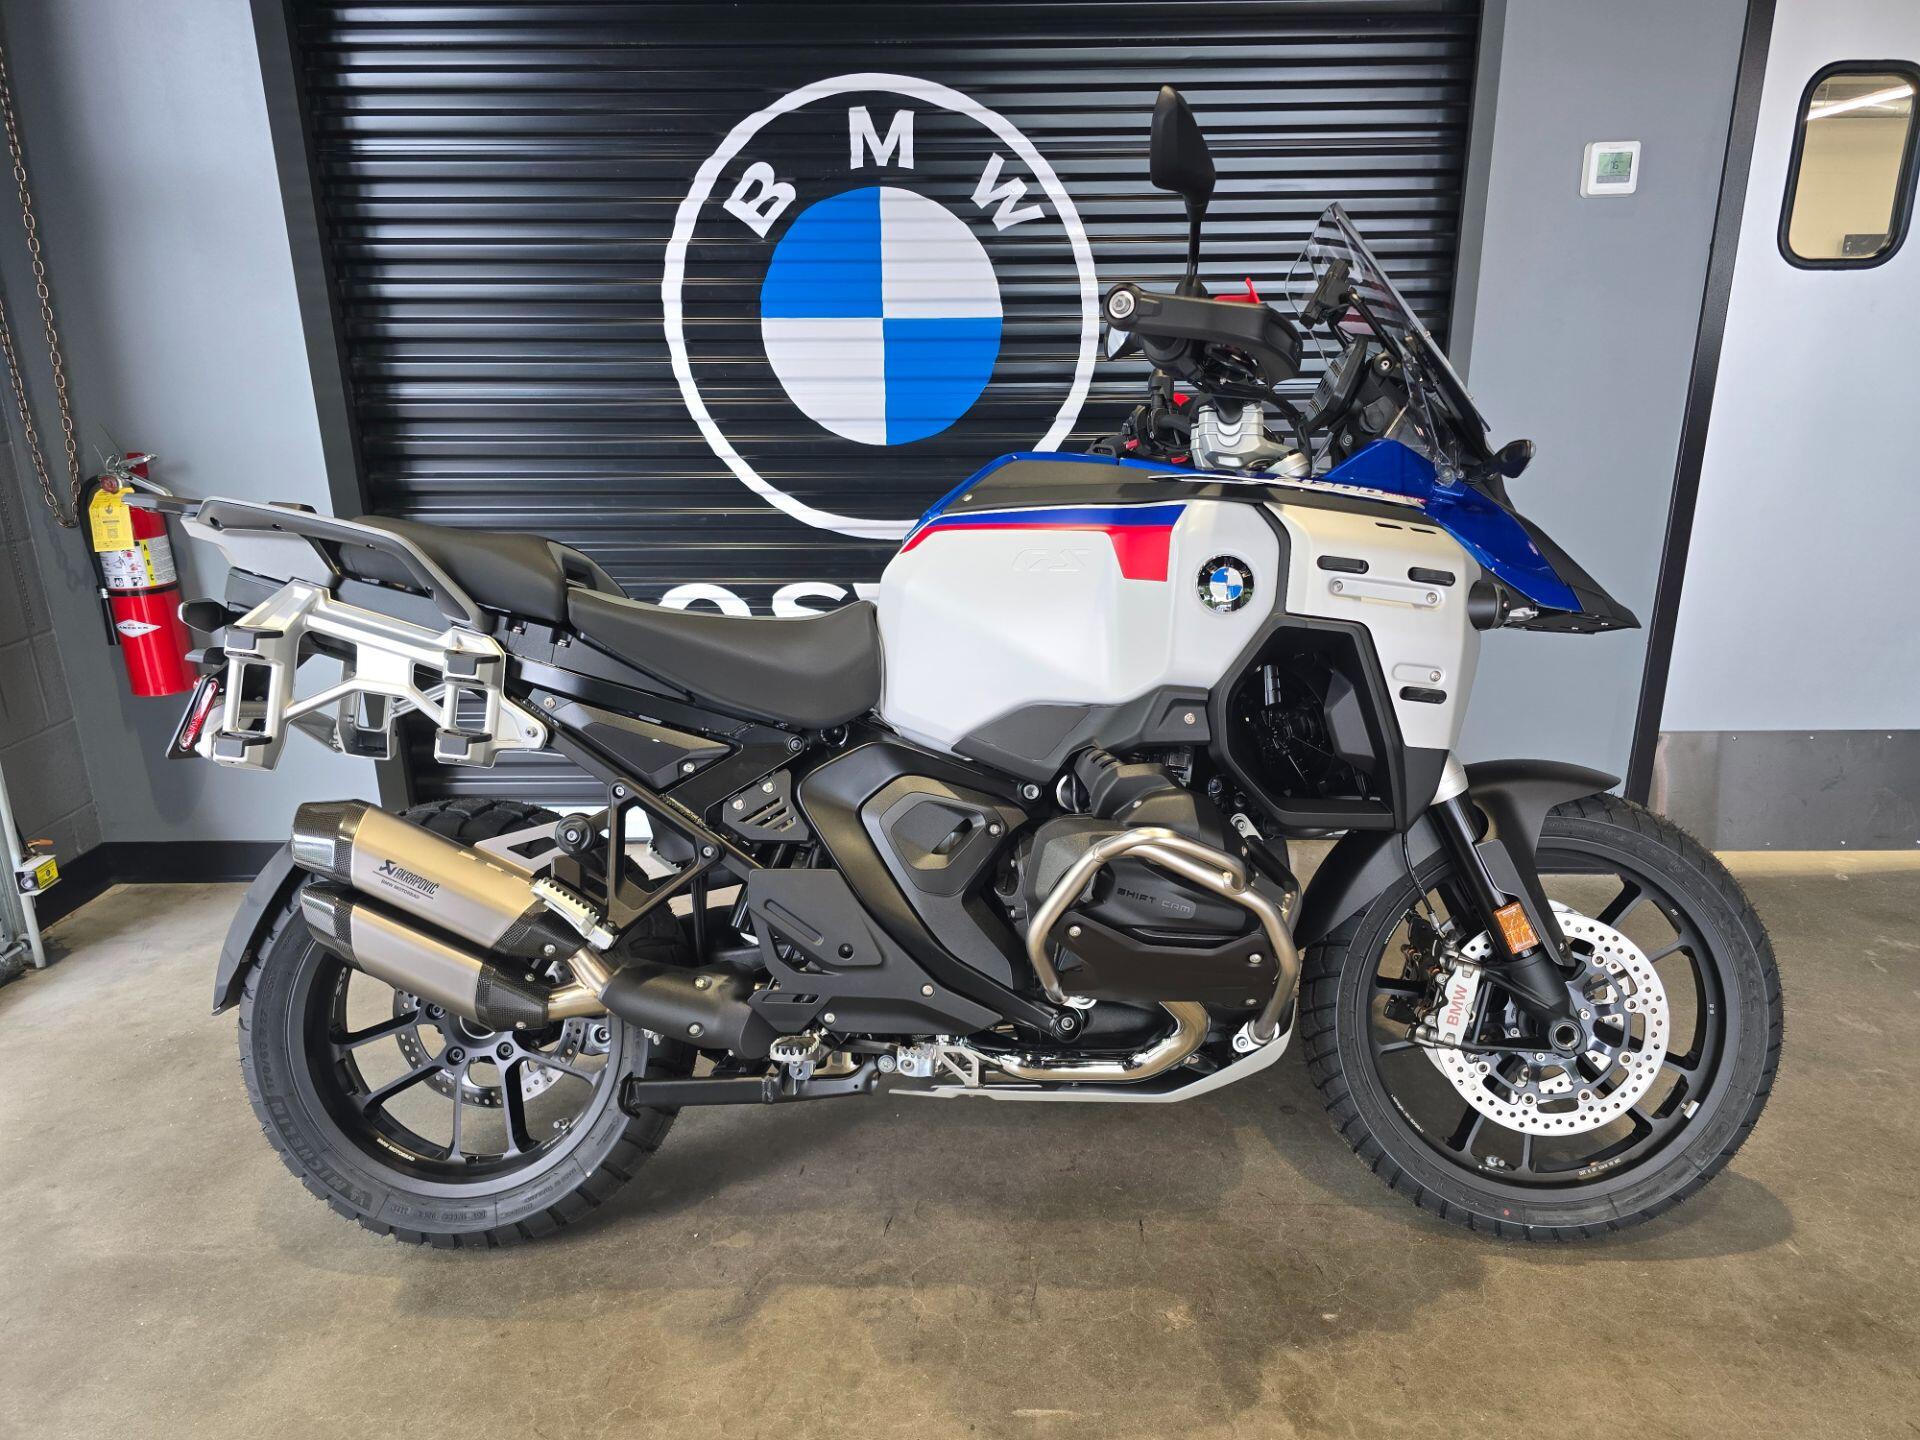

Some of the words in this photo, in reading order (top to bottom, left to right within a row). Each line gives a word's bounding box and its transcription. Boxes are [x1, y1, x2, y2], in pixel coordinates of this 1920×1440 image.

[723, 106, 1045, 238] BMW
[1117, 887, 1157, 904] SHIFT
[1447, 984, 1468, 1026] BMW
[268, 1101, 348, 1191] MICHELIN
